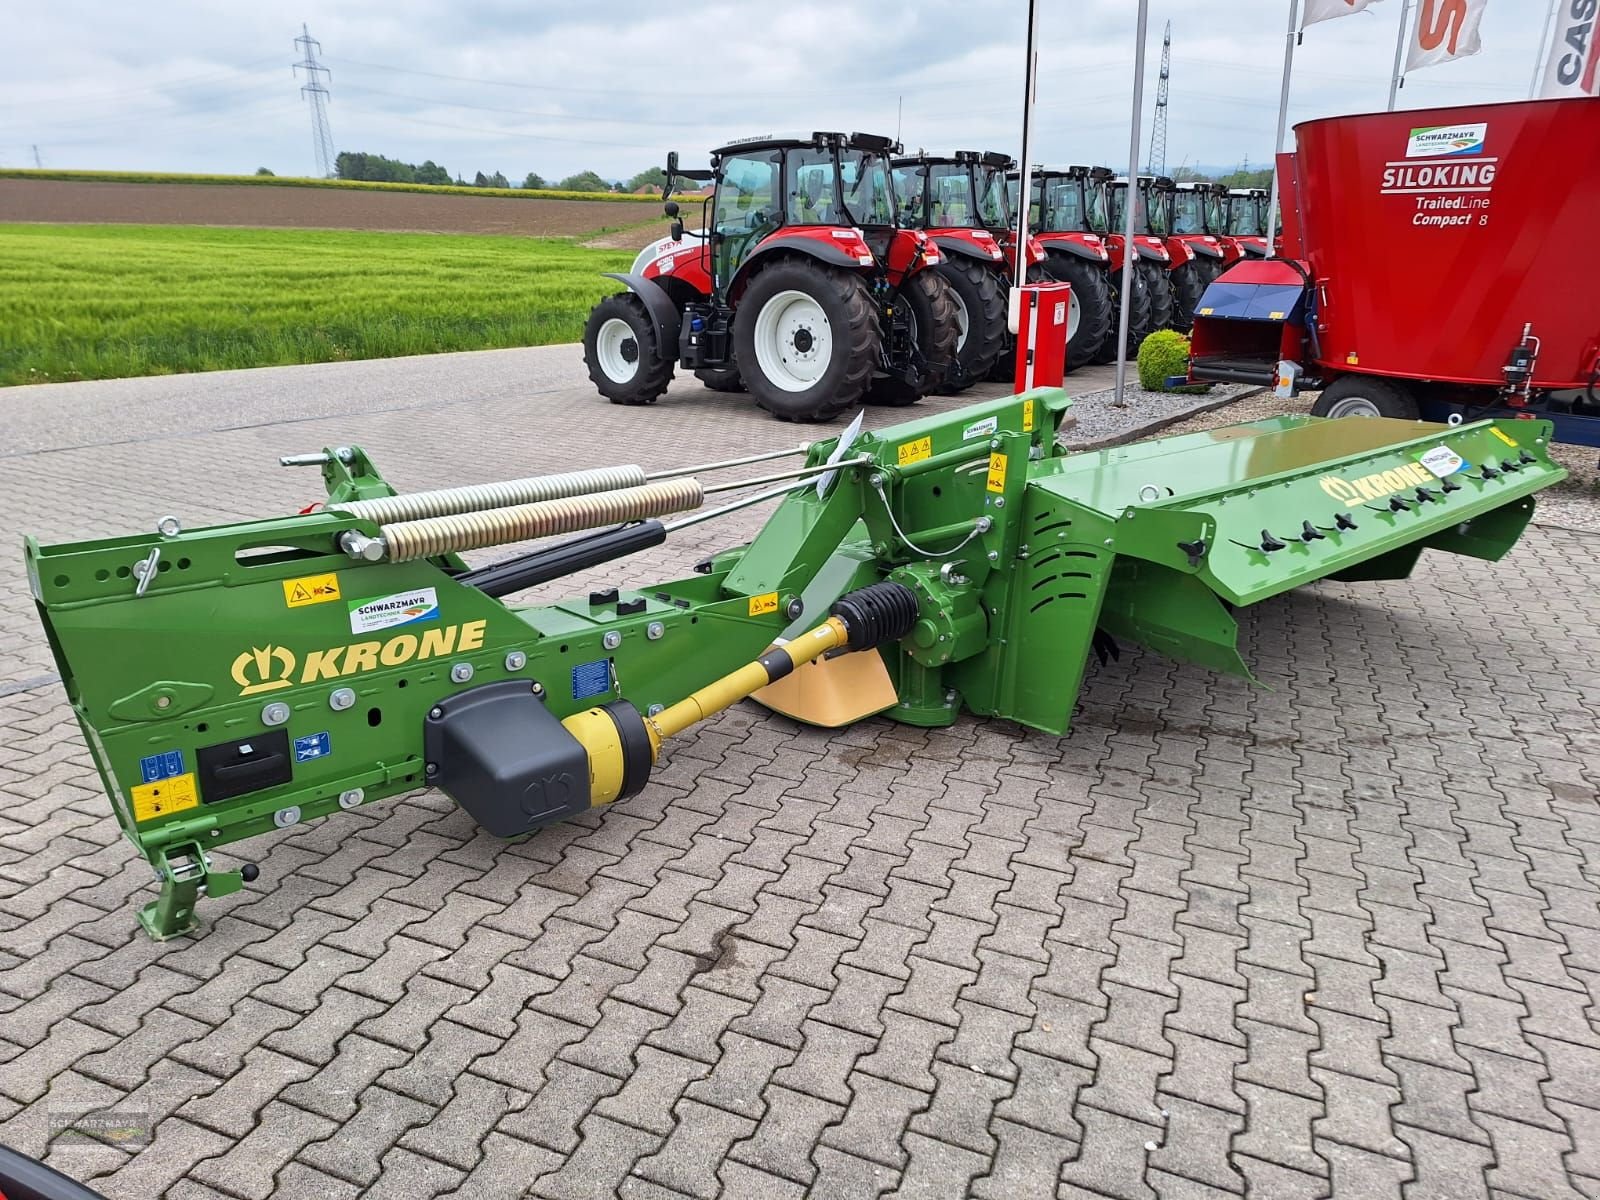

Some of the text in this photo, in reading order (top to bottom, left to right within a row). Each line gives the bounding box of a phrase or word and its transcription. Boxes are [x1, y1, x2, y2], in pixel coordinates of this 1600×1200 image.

[1415, 131, 1475, 142] SCHWARZMAYR
[1381, 164, 1496, 188] SILOKING
[1416, 195, 1490, 209] TrailedLine
[1412, 212, 1488, 229] Compact 8
[1351, 461, 1434, 501] KRONE
[358, 597, 425, 615] SCHWARZMAYR
[360, 610, 401, 622] LANDTECHNIK
[300, 619, 487, 684] KRONE
